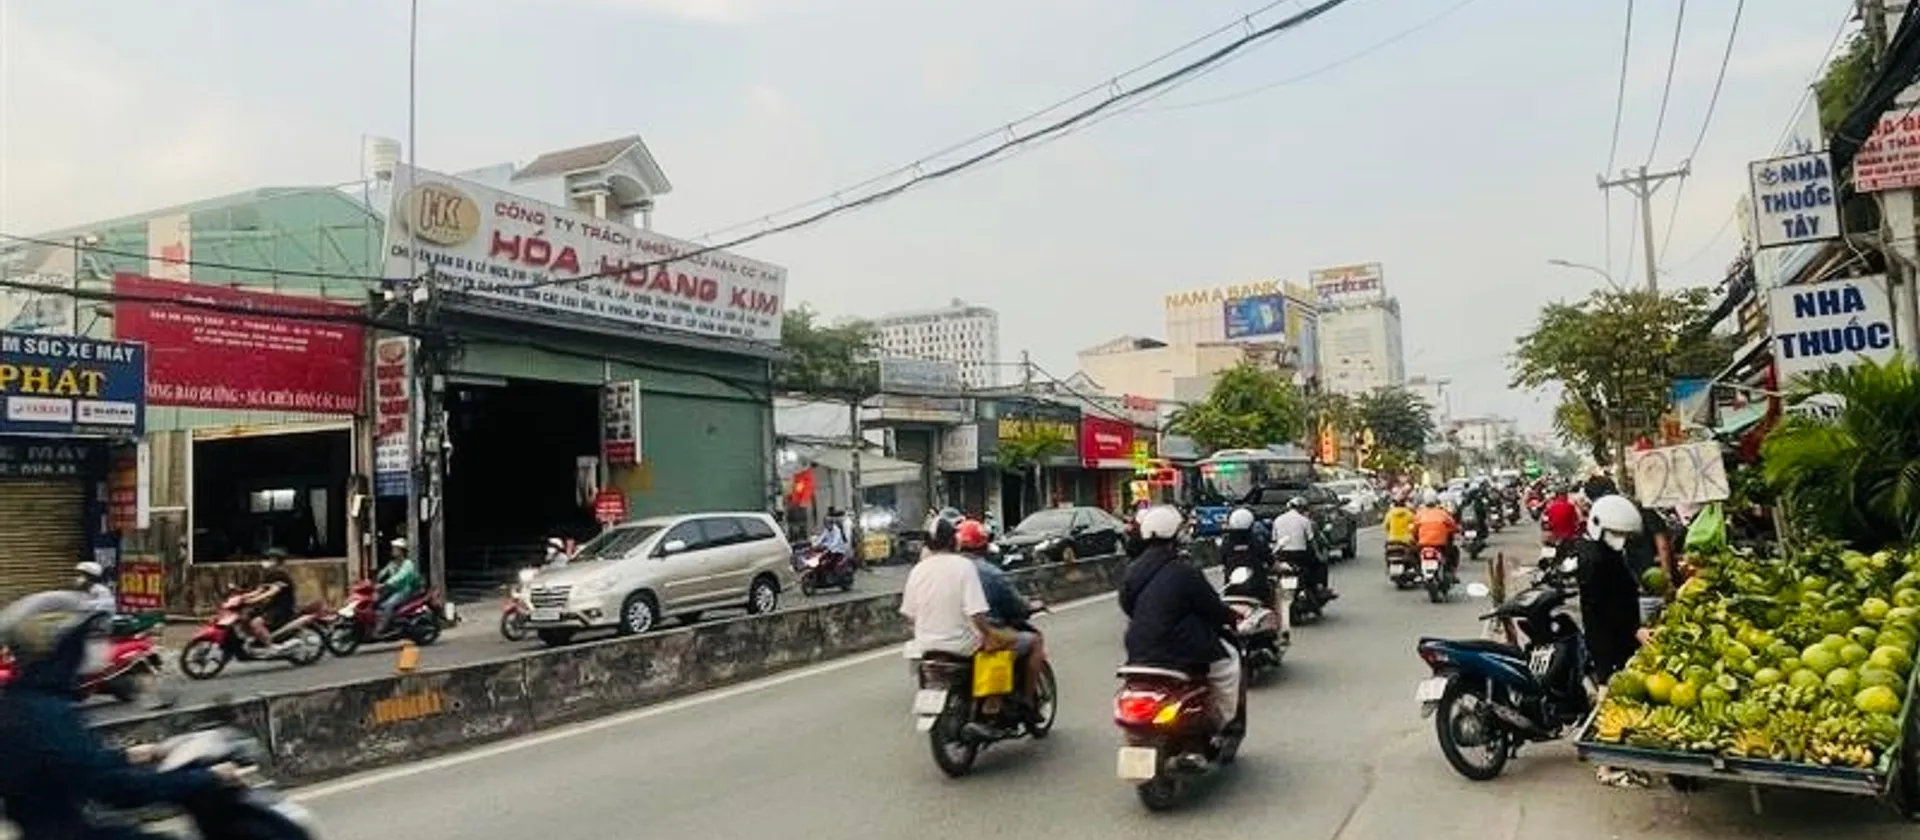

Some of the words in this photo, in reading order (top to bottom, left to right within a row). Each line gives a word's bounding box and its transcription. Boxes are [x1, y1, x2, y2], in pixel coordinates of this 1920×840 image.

[1781, 156, 1828, 182] NHÀ
[1762, 182, 1832, 213] THUỐC
[495, 201, 546, 227] CÔNG
[553, 215, 575, 233] TY
[581, 223, 633, 247] TRÁCH
[1782, 214, 1820, 239] TÂY
[489, 228, 581, 275] HÓA
[729, 284, 779, 316] KIM
[1166, 290, 1208, 310] NAM
[1227, 279, 1280, 301] BANK
[1793, 283, 1866, 318] NHÀ
[67, 342, 92, 359] XE
[1777, 316, 1890, 359] THUỐC
[0, 361, 107, 395] PHÁT
